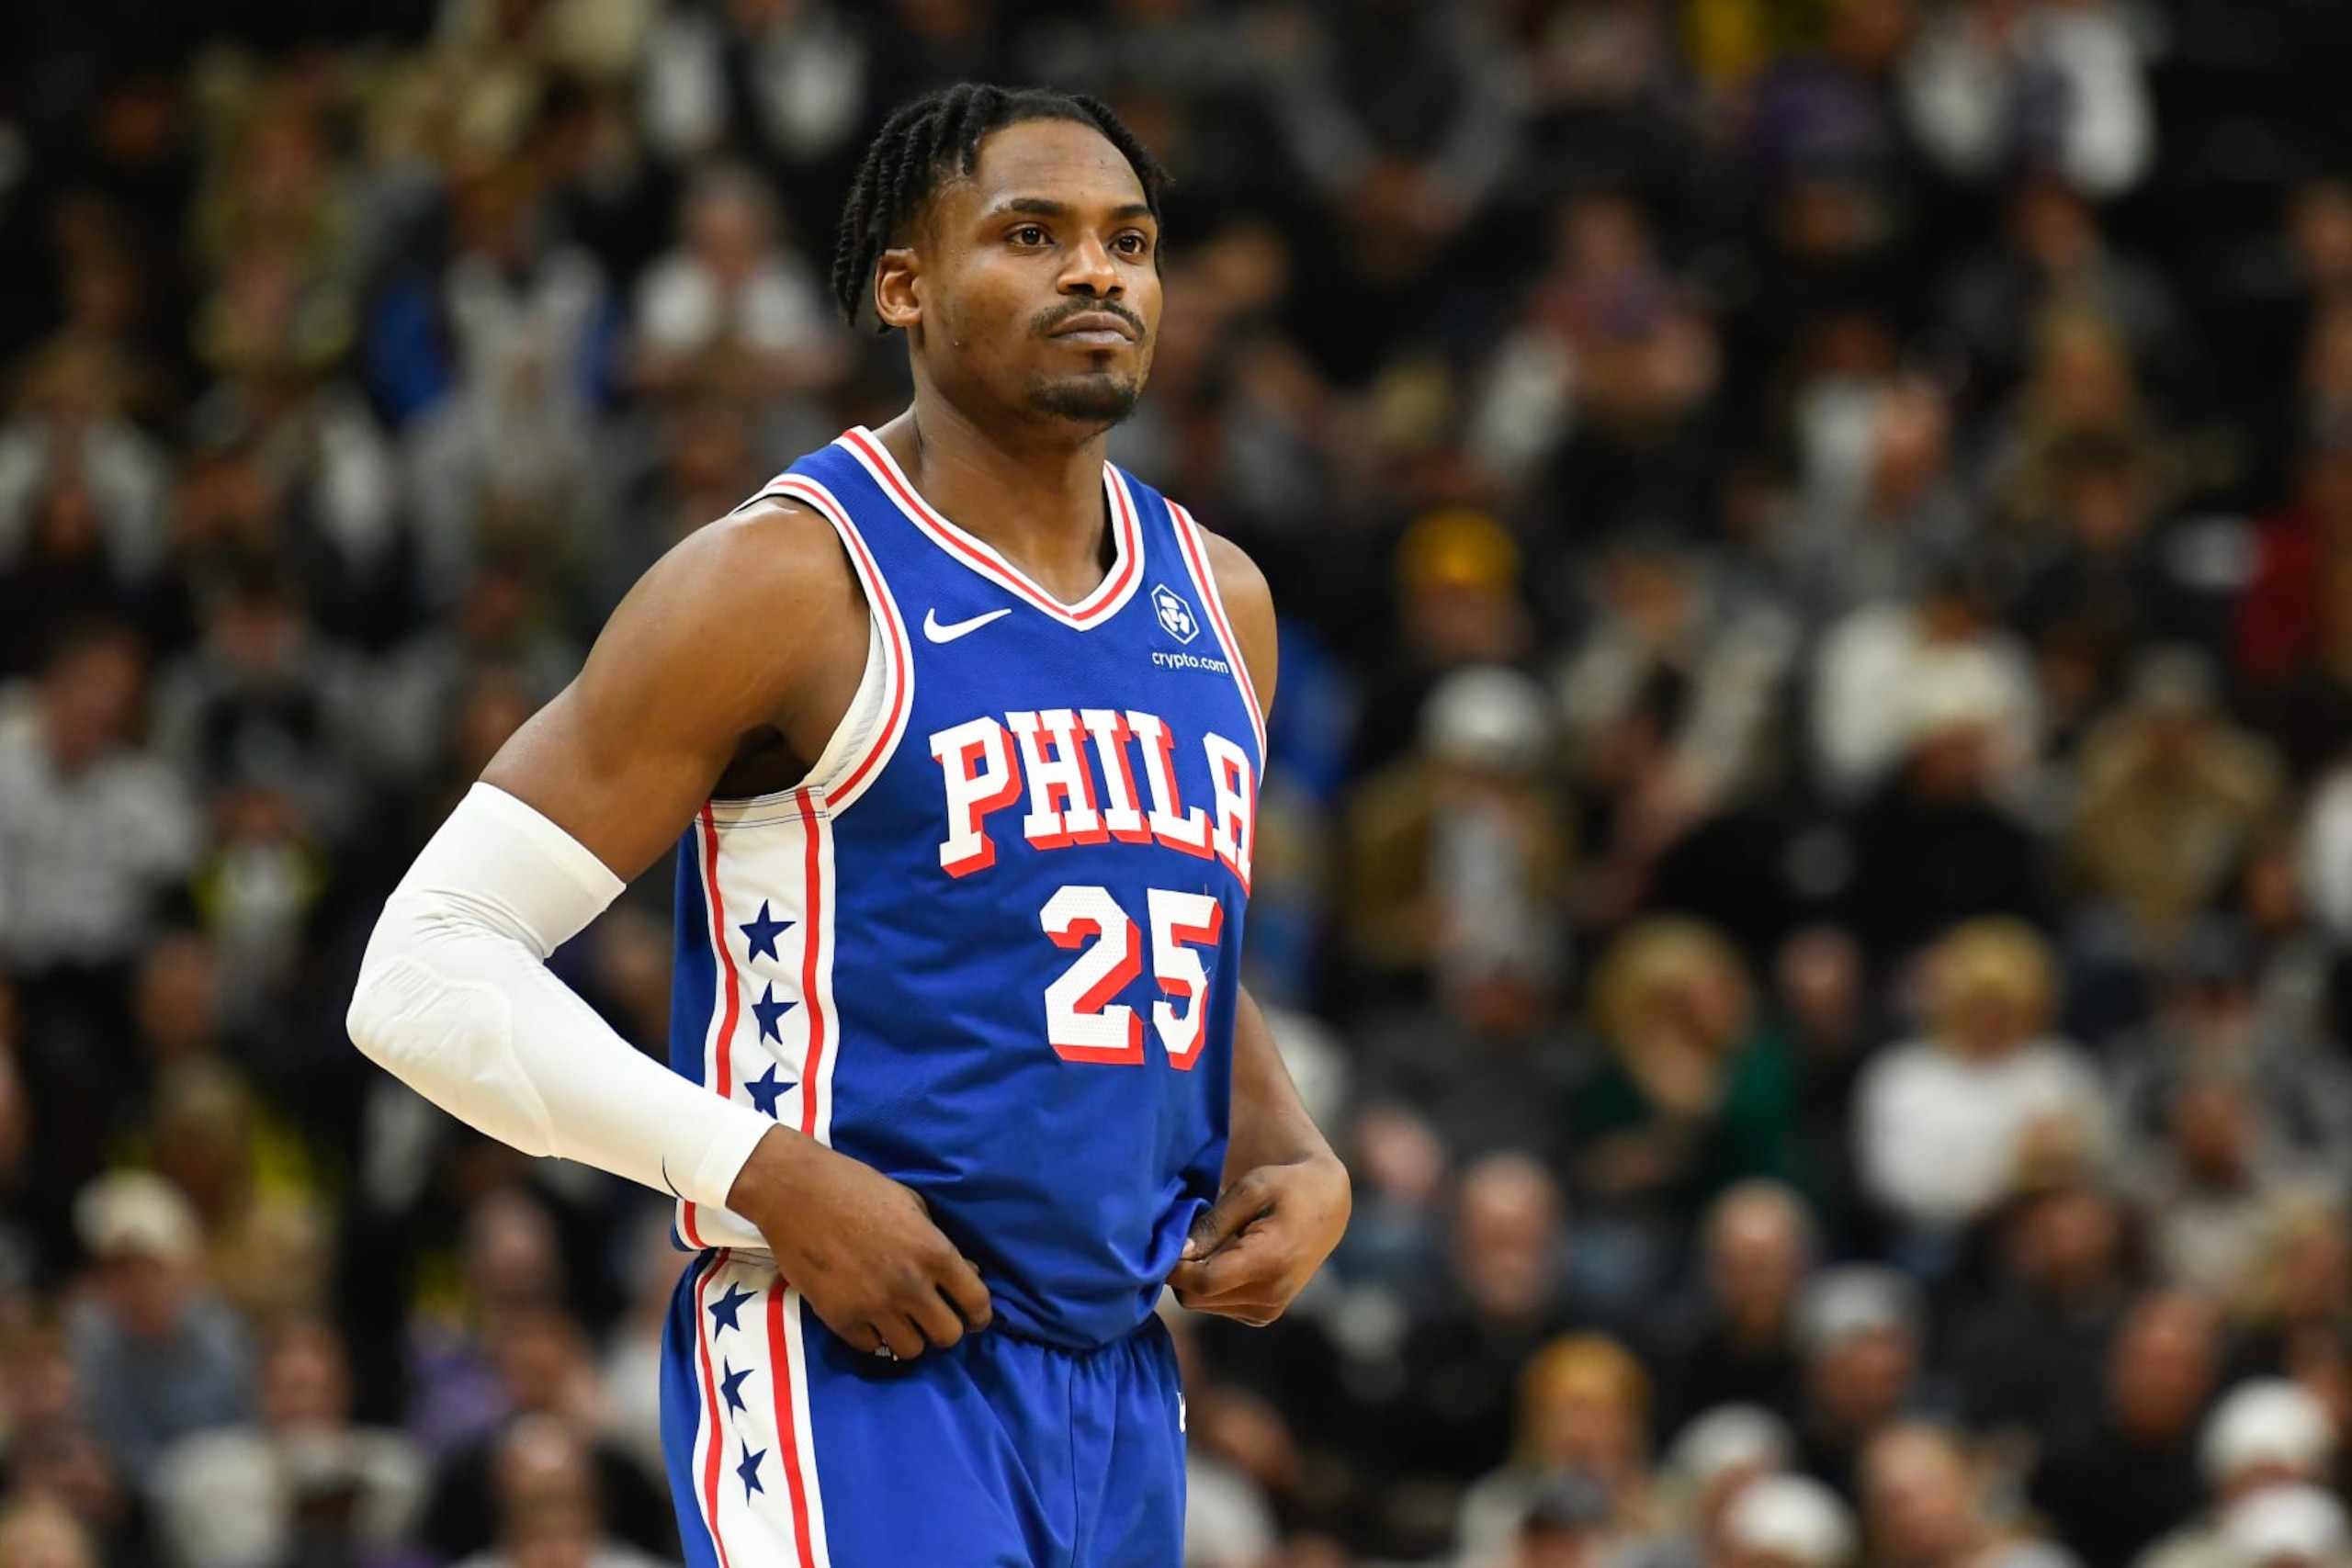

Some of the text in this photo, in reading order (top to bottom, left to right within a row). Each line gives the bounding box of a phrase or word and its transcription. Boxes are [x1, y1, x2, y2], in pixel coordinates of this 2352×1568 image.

[1151, 651, 1229, 673] crypto.com
[930, 709, 1252, 898] PHILA
[1039, 886, 1224, 1071] 25
